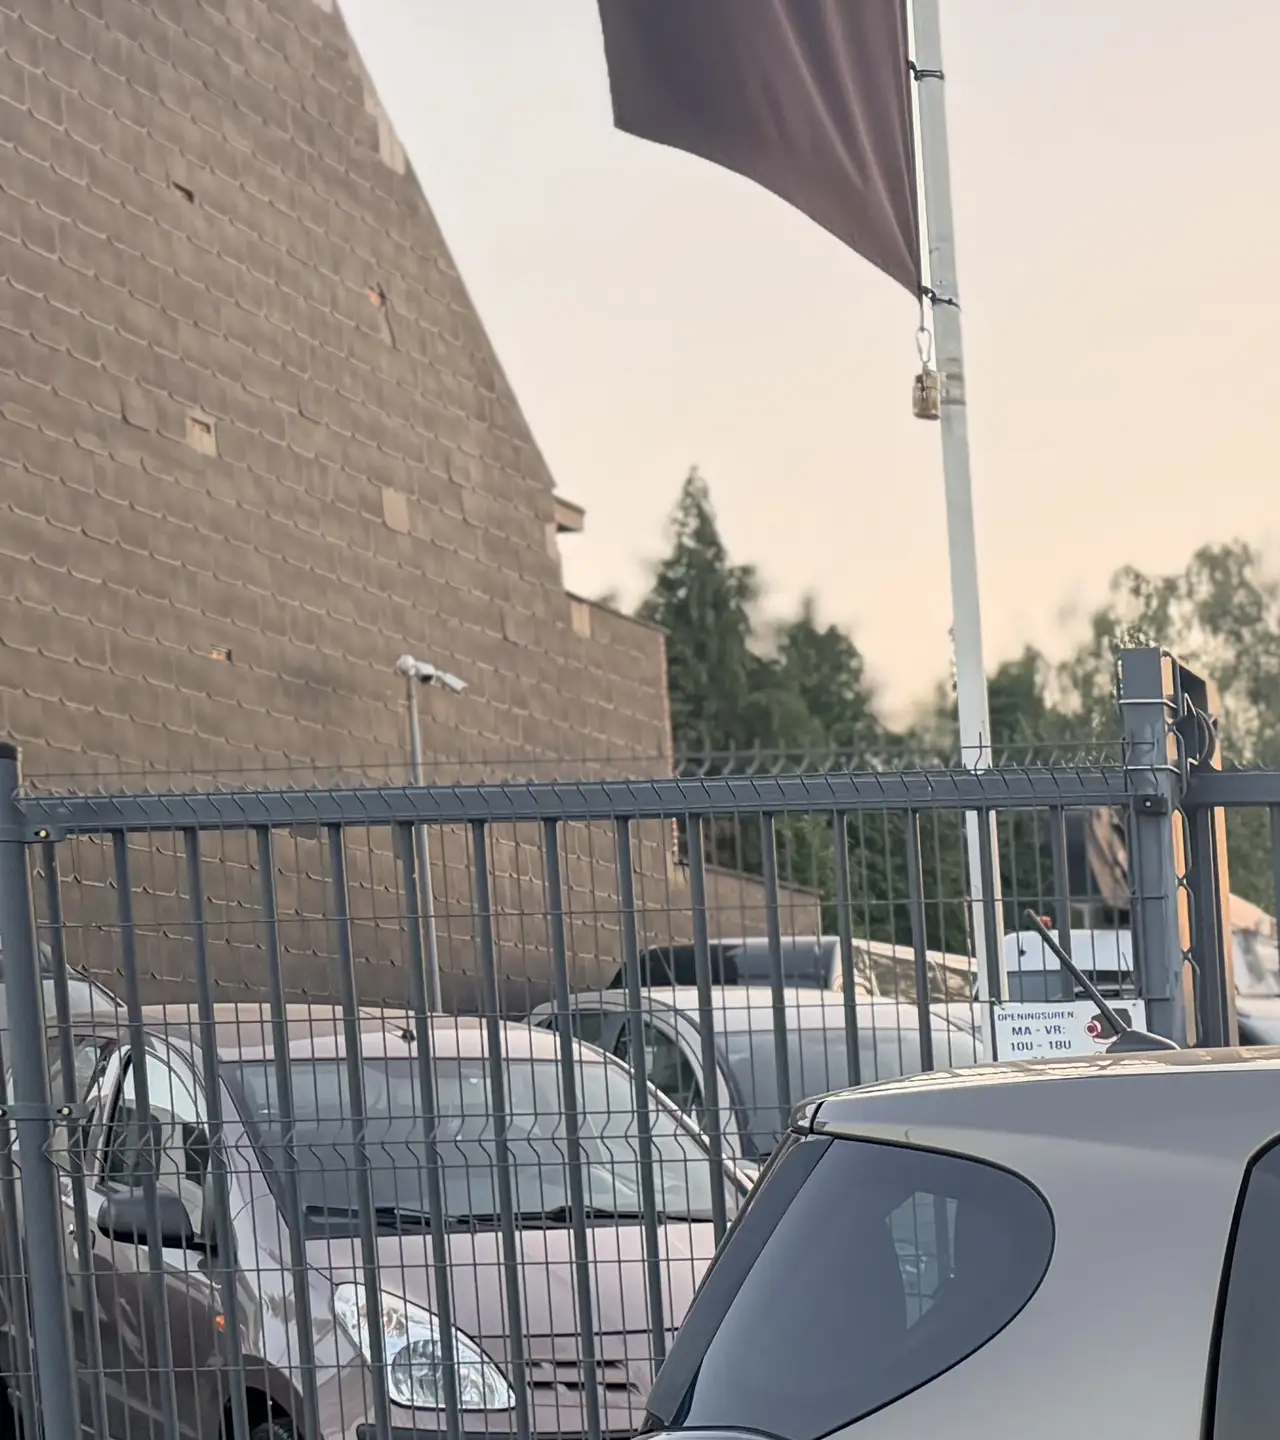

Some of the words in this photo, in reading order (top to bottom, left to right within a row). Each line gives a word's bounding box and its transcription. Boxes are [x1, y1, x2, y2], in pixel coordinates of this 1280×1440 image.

[1011, 1026, 1032, 1036] MA
[1011, 1041, 1034, 1052] 10U
[1048, 1039, 1072, 1051] 18U
